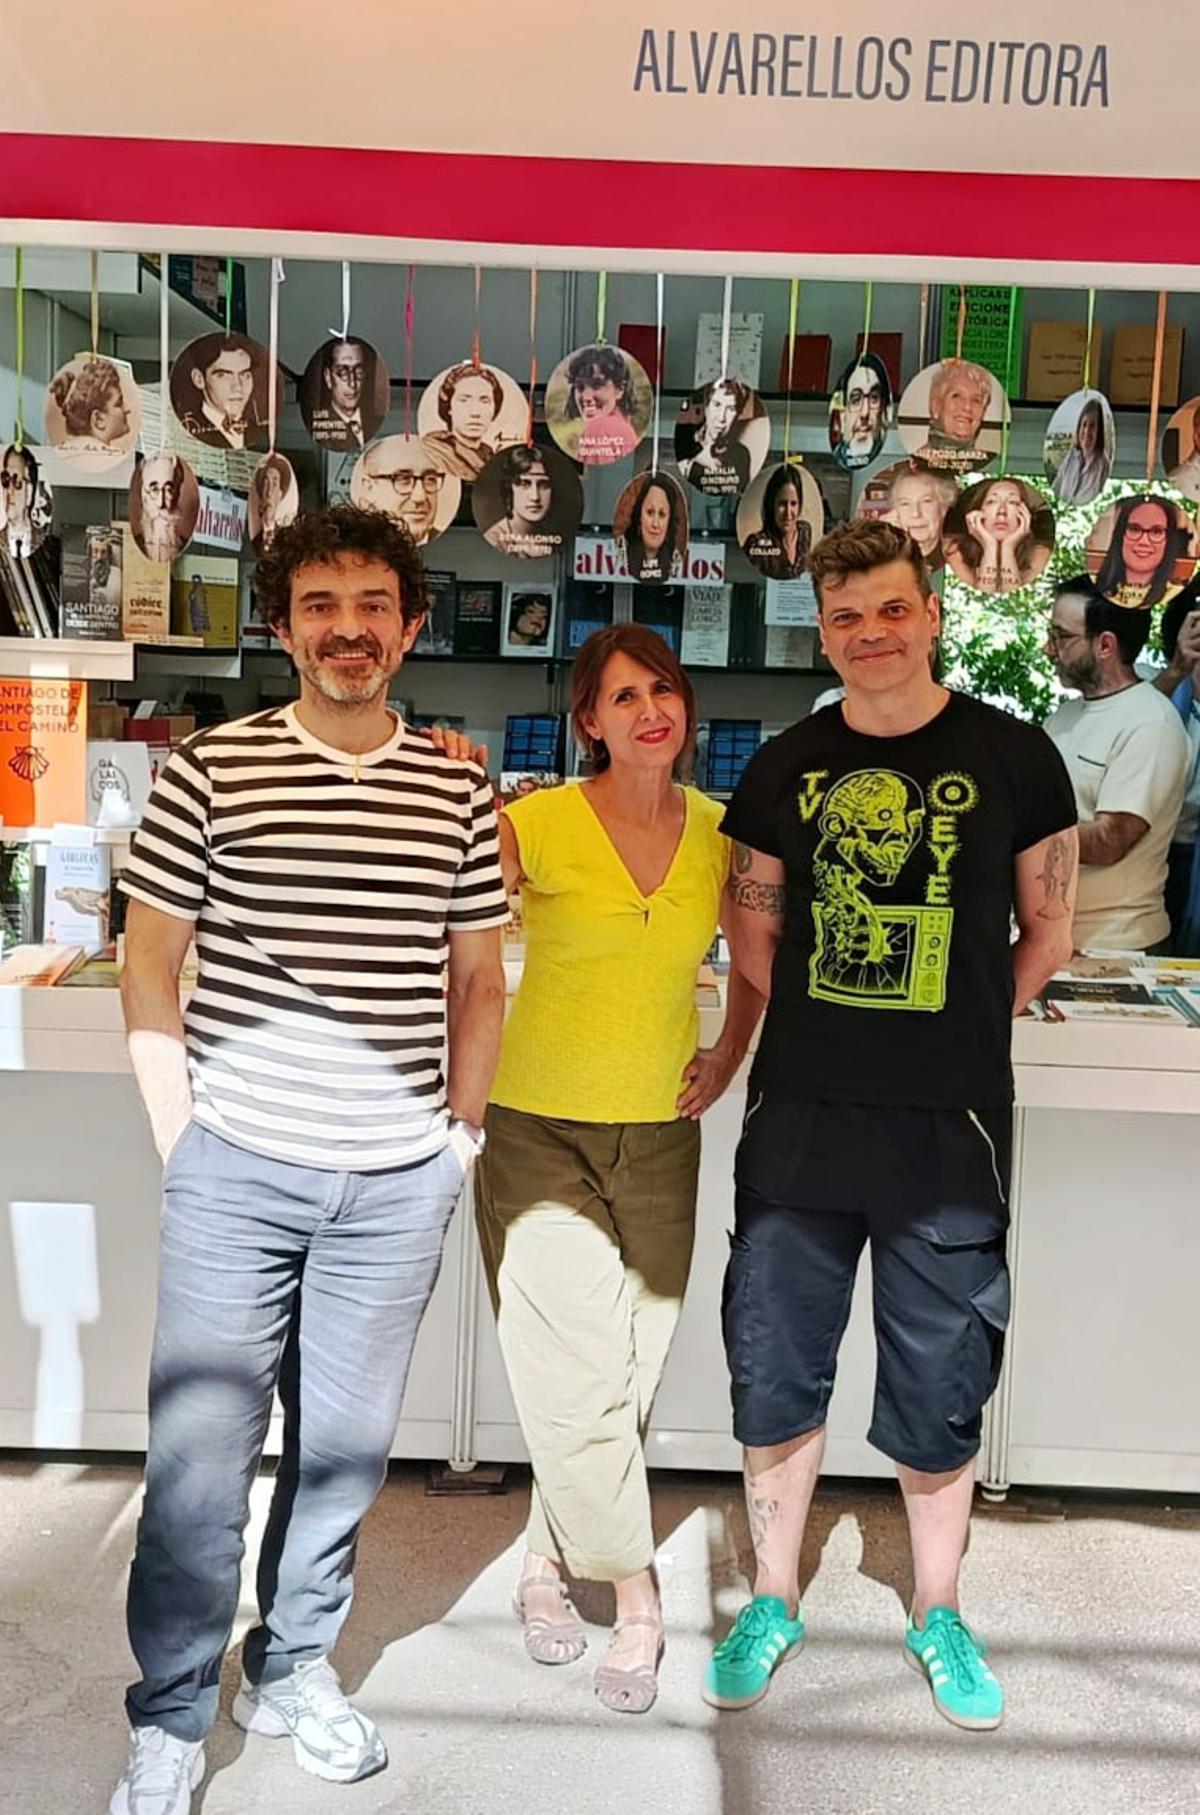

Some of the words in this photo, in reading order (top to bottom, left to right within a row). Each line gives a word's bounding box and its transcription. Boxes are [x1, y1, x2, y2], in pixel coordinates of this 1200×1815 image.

[632, 28, 913, 102] ALVARELLOS
[924, 39, 1110, 108] EDITORA
[579, 437, 596, 445] ANA
[598, 435, 624, 446] LÓPEZ
[523, 534, 562, 545] ALONSO
[65, 601, 120, 616] SANTIAGO
[60, 687, 81, 699] DE
[18, 721, 80, 734] CAMINO
